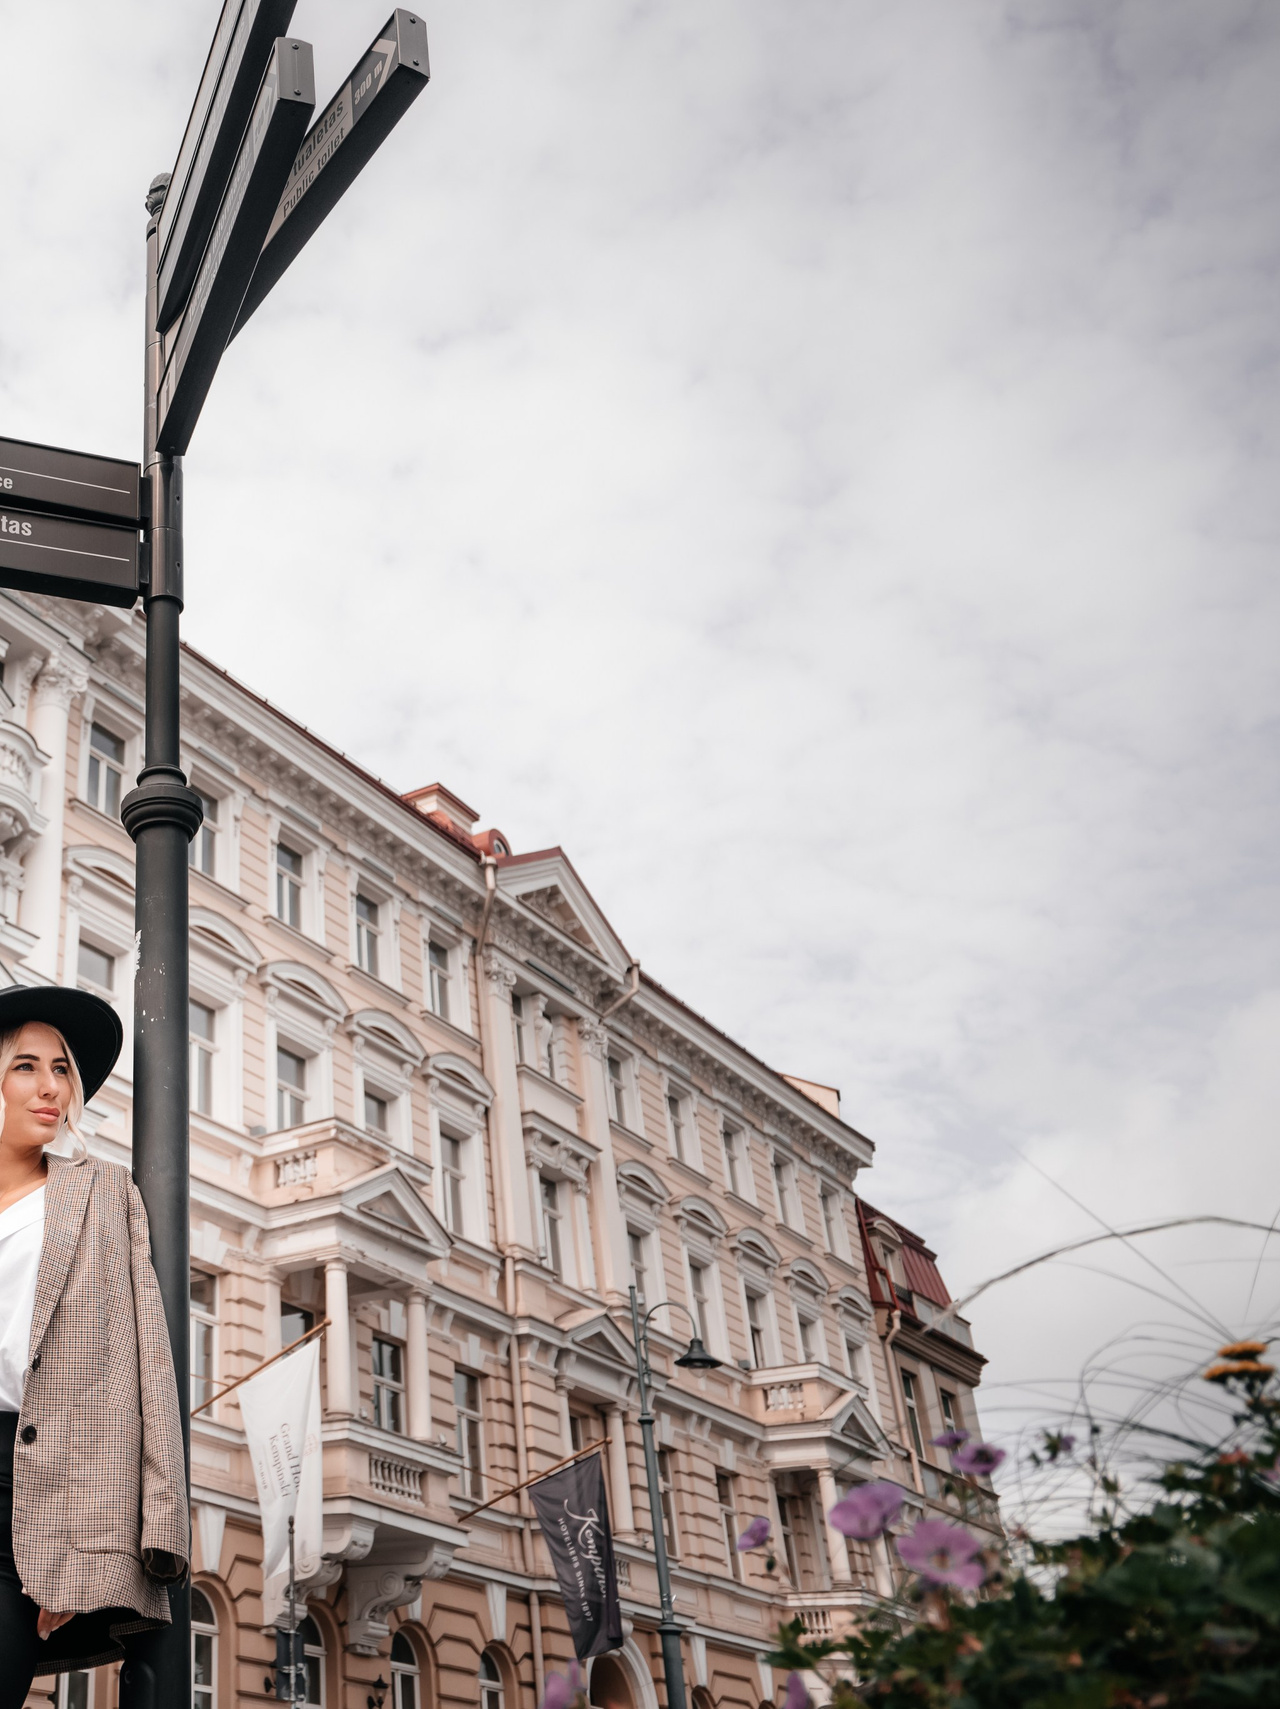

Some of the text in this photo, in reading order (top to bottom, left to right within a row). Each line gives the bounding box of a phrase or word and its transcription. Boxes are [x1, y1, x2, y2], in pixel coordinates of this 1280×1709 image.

[355, 60, 383, 105] 300 m
[293, 101, 344, 176] tualetas
[283, 127, 345, 218] Public toilet
[269, 1434, 291, 1497] Kempinski
[281, 1423, 299, 1461] Grand
[581, 1601, 594, 1622] 1897
